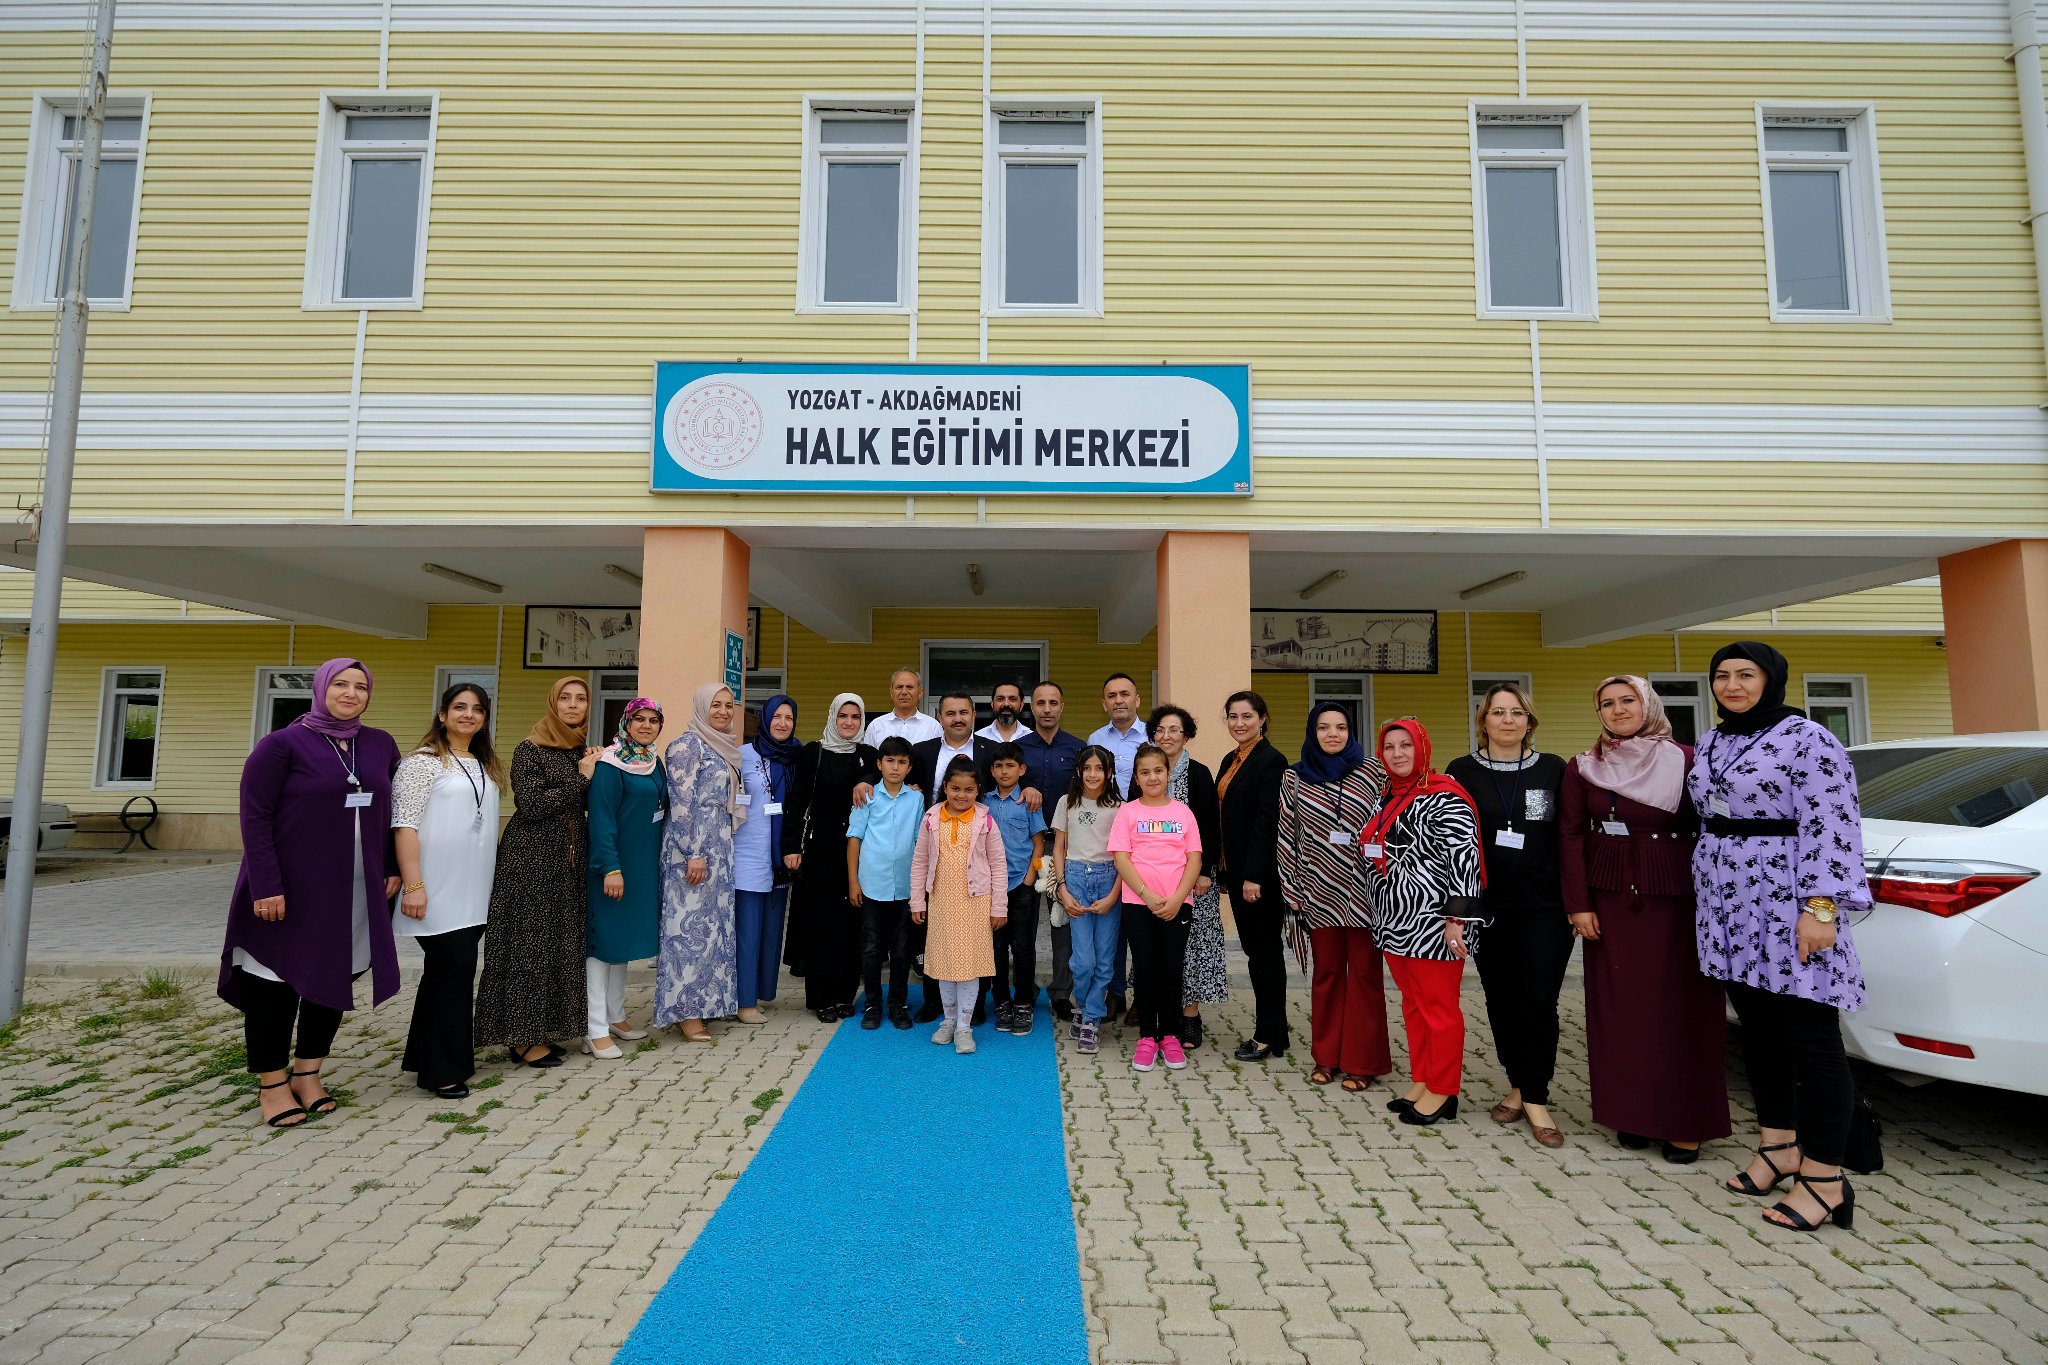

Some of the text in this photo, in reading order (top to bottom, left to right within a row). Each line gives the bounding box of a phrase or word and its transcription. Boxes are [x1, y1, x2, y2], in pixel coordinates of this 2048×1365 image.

[787, 389, 862, 411] YOZGAT
[879, 385, 1021, 412] AKDAĞMADENİ
[786, 416, 1190, 468] HALK EĞİTİMİ MERKEZİ
